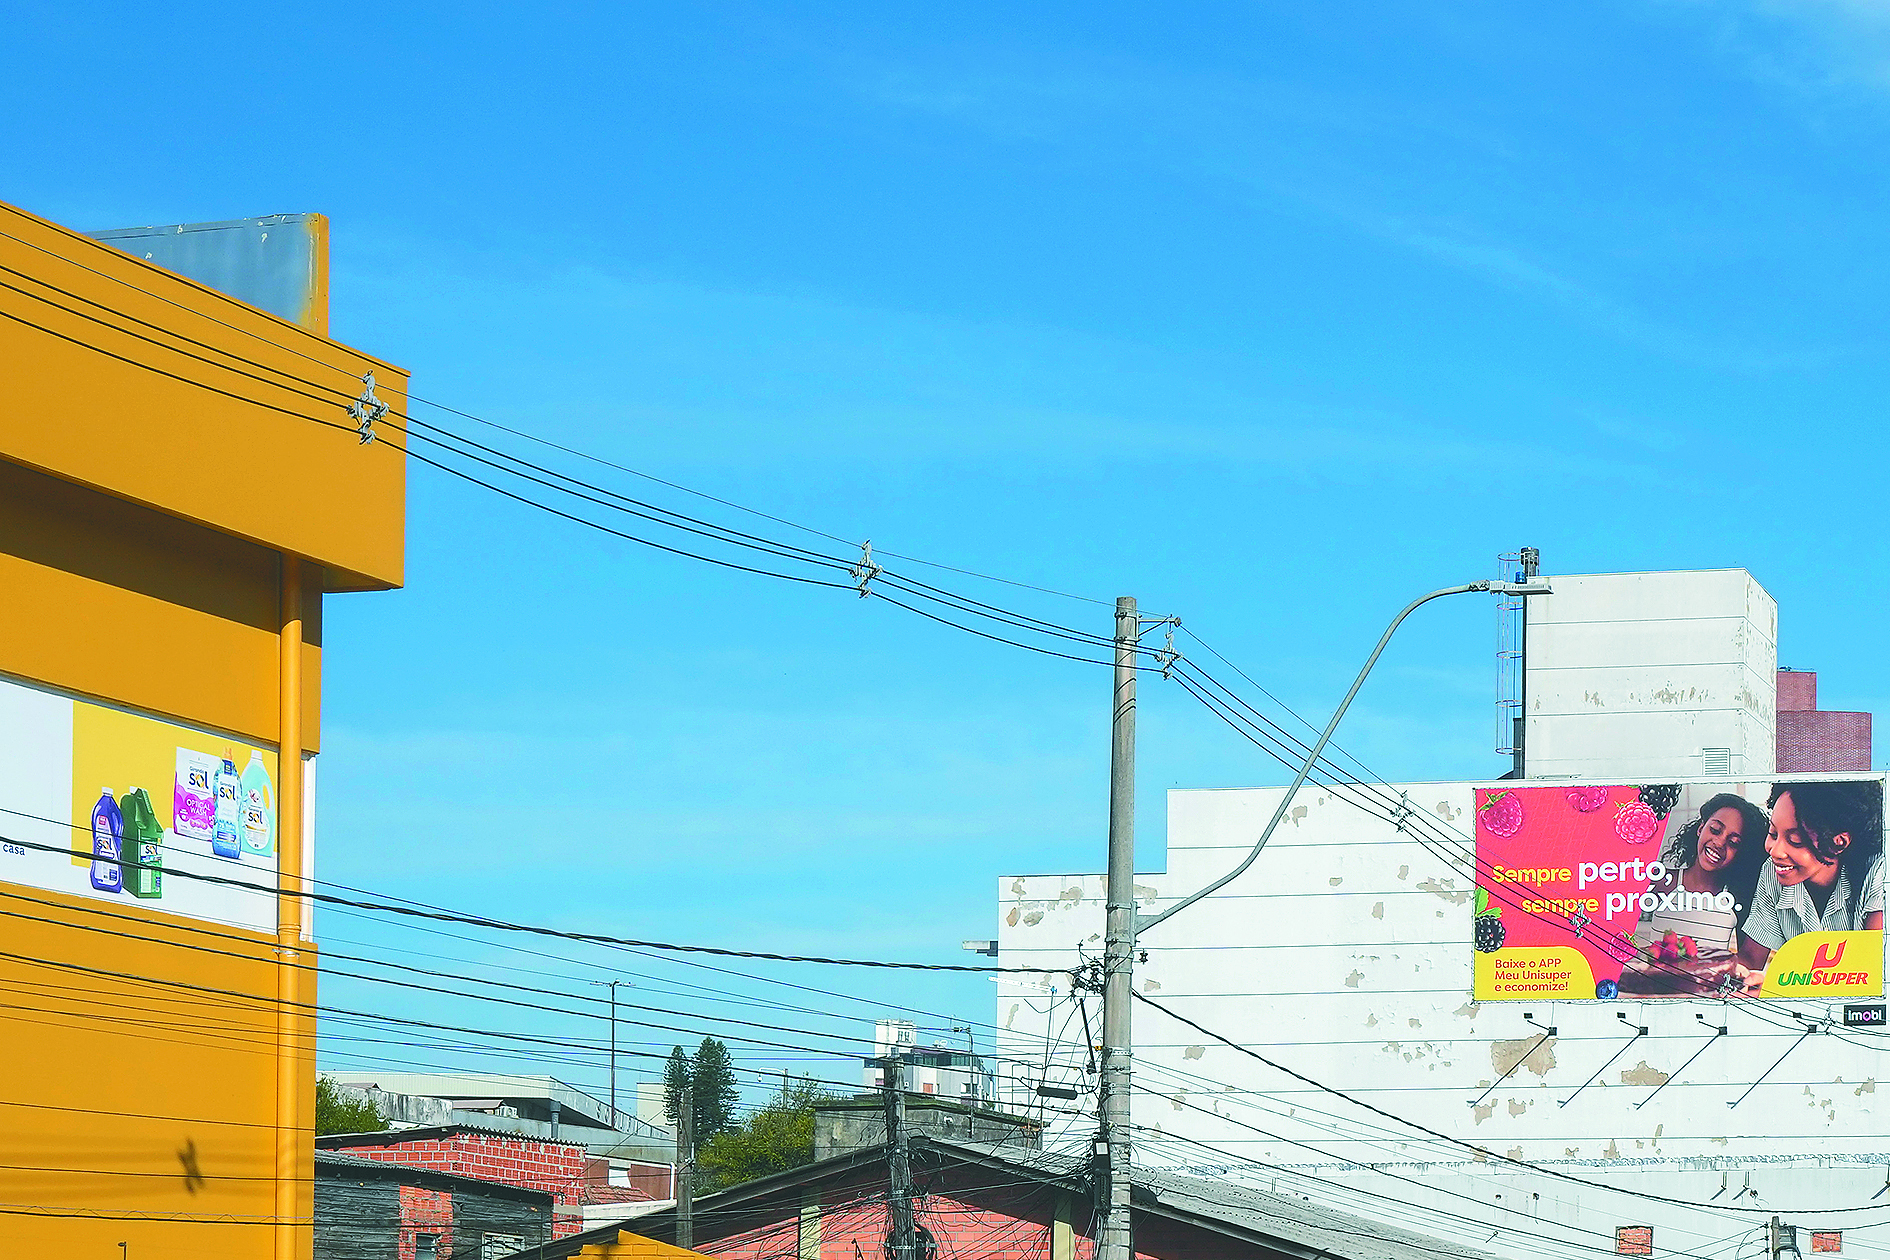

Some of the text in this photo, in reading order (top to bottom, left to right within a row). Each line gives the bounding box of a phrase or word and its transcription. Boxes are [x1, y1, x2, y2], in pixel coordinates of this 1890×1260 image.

[2, 843, 26, 856] casa
[1492, 857, 1673, 890] Sempre perto,
[1521, 885, 1743, 921] sempre próximo.
[1495, 958, 1562, 969] Baixe o APP
[1494, 969, 1572, 983] Meu Unisuper
[1494, 982, 1568, 993] e economize!
